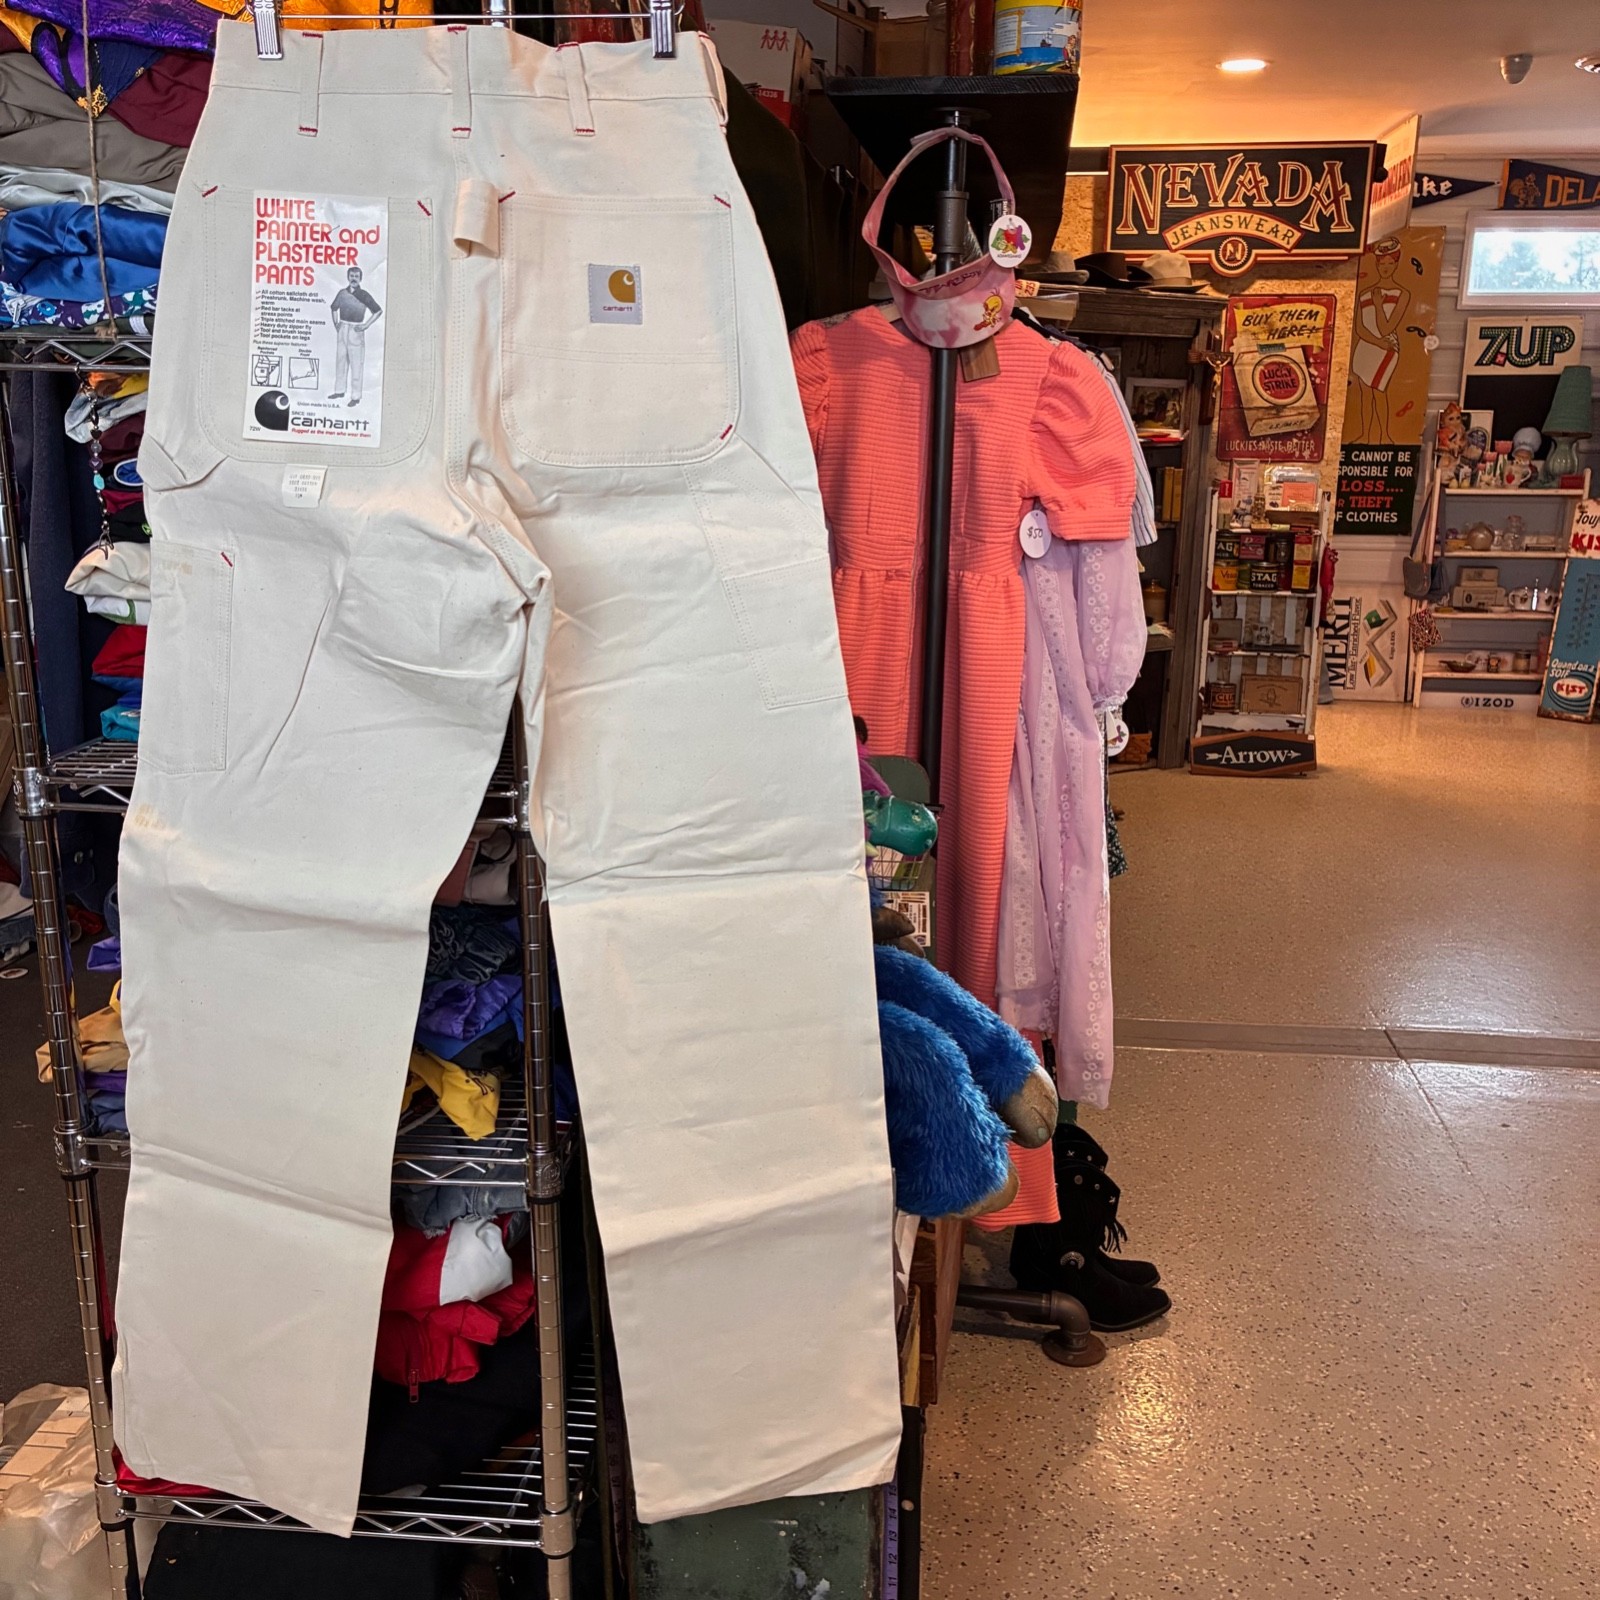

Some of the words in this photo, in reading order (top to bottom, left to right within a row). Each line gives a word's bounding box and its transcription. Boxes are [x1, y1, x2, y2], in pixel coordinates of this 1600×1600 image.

[1116, 152, 1354, 234] NEVADA
[256, 198, 315, 220] WHITE
[256, 220, 332, 242] PAINTER
[338, 225, 380, 244] and
[1171, 213, 1296, 247] JEANSWEAR
[256, 242, 358, 266] PLASTERER
[1226, 242, 1242, 262] N
[255, 264, 315, 286] PANTS
[1242, 312, 1272, 326] BUY
[1278, 310, 1320, 322] THEM
[1474, 326, 1576, 368] 7UP
[1263, 367, 1292, 379] LUCKY
[1264, 378, 1298, 391] STRIKE
[291, 416, 370, 431] carhartt
[1226, 440, 1257, 451] LUCKIES
[1286, 440, 1315, 452] BETTER
[1352, 451, 1394, 462] CANNOT
[1398, 452, 1411, 462] BE
[1394, 466, 1413, 477] FOR
[1349, 496, 1393, 508] THEFT
[1346, 512, 1398, 523] CLOTHES
[1216, 542, 1233, 552] AG
[1251, 573, 1277, 582] STAG
[1551, 658, 1579, 670] Quand
[1550, 669, 1570, 678] SOIF
[1346, 674, 1355, 690] Low
[1556, 683, 1585, 695] KIST
[1475, 698, 1514, 708] IZOD
[1220, 745, 1288, 765] Arrow
[888, 1485, 897, 1496] 15
[889, 1508, 897, 1519] 14
[889, 1530, 897, 1542] 13
[888, 1552, 897, 1565] 12
[888, 1576, 897, 1587] 11
